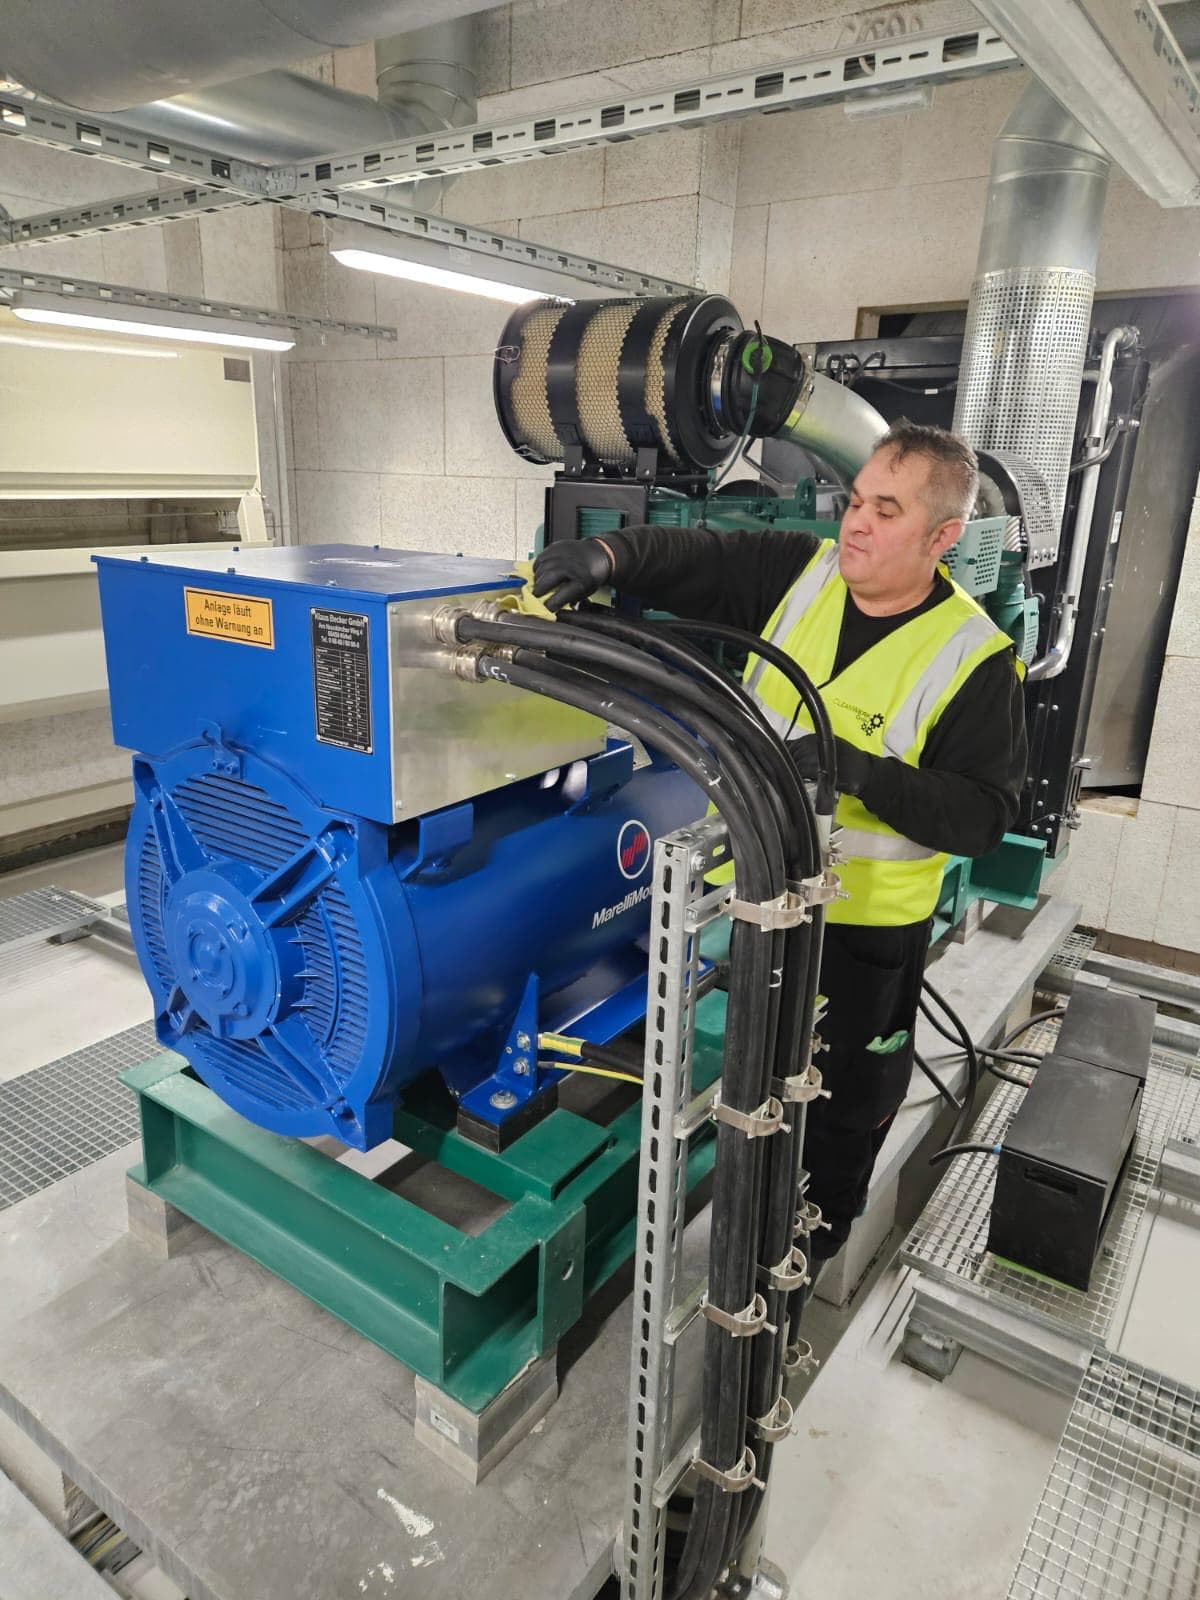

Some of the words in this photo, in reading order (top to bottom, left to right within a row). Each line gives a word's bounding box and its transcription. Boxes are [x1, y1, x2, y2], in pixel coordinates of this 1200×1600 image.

[204, 599, 231, 616] Anlage
[233, 604, 252, 617] läuft
[195, 614, 214, 627] ohne
[215, 617, 251, 636] Warnung
[253, 626, 263, 636] an
[592, 885, 653, 929] MarelliMo
